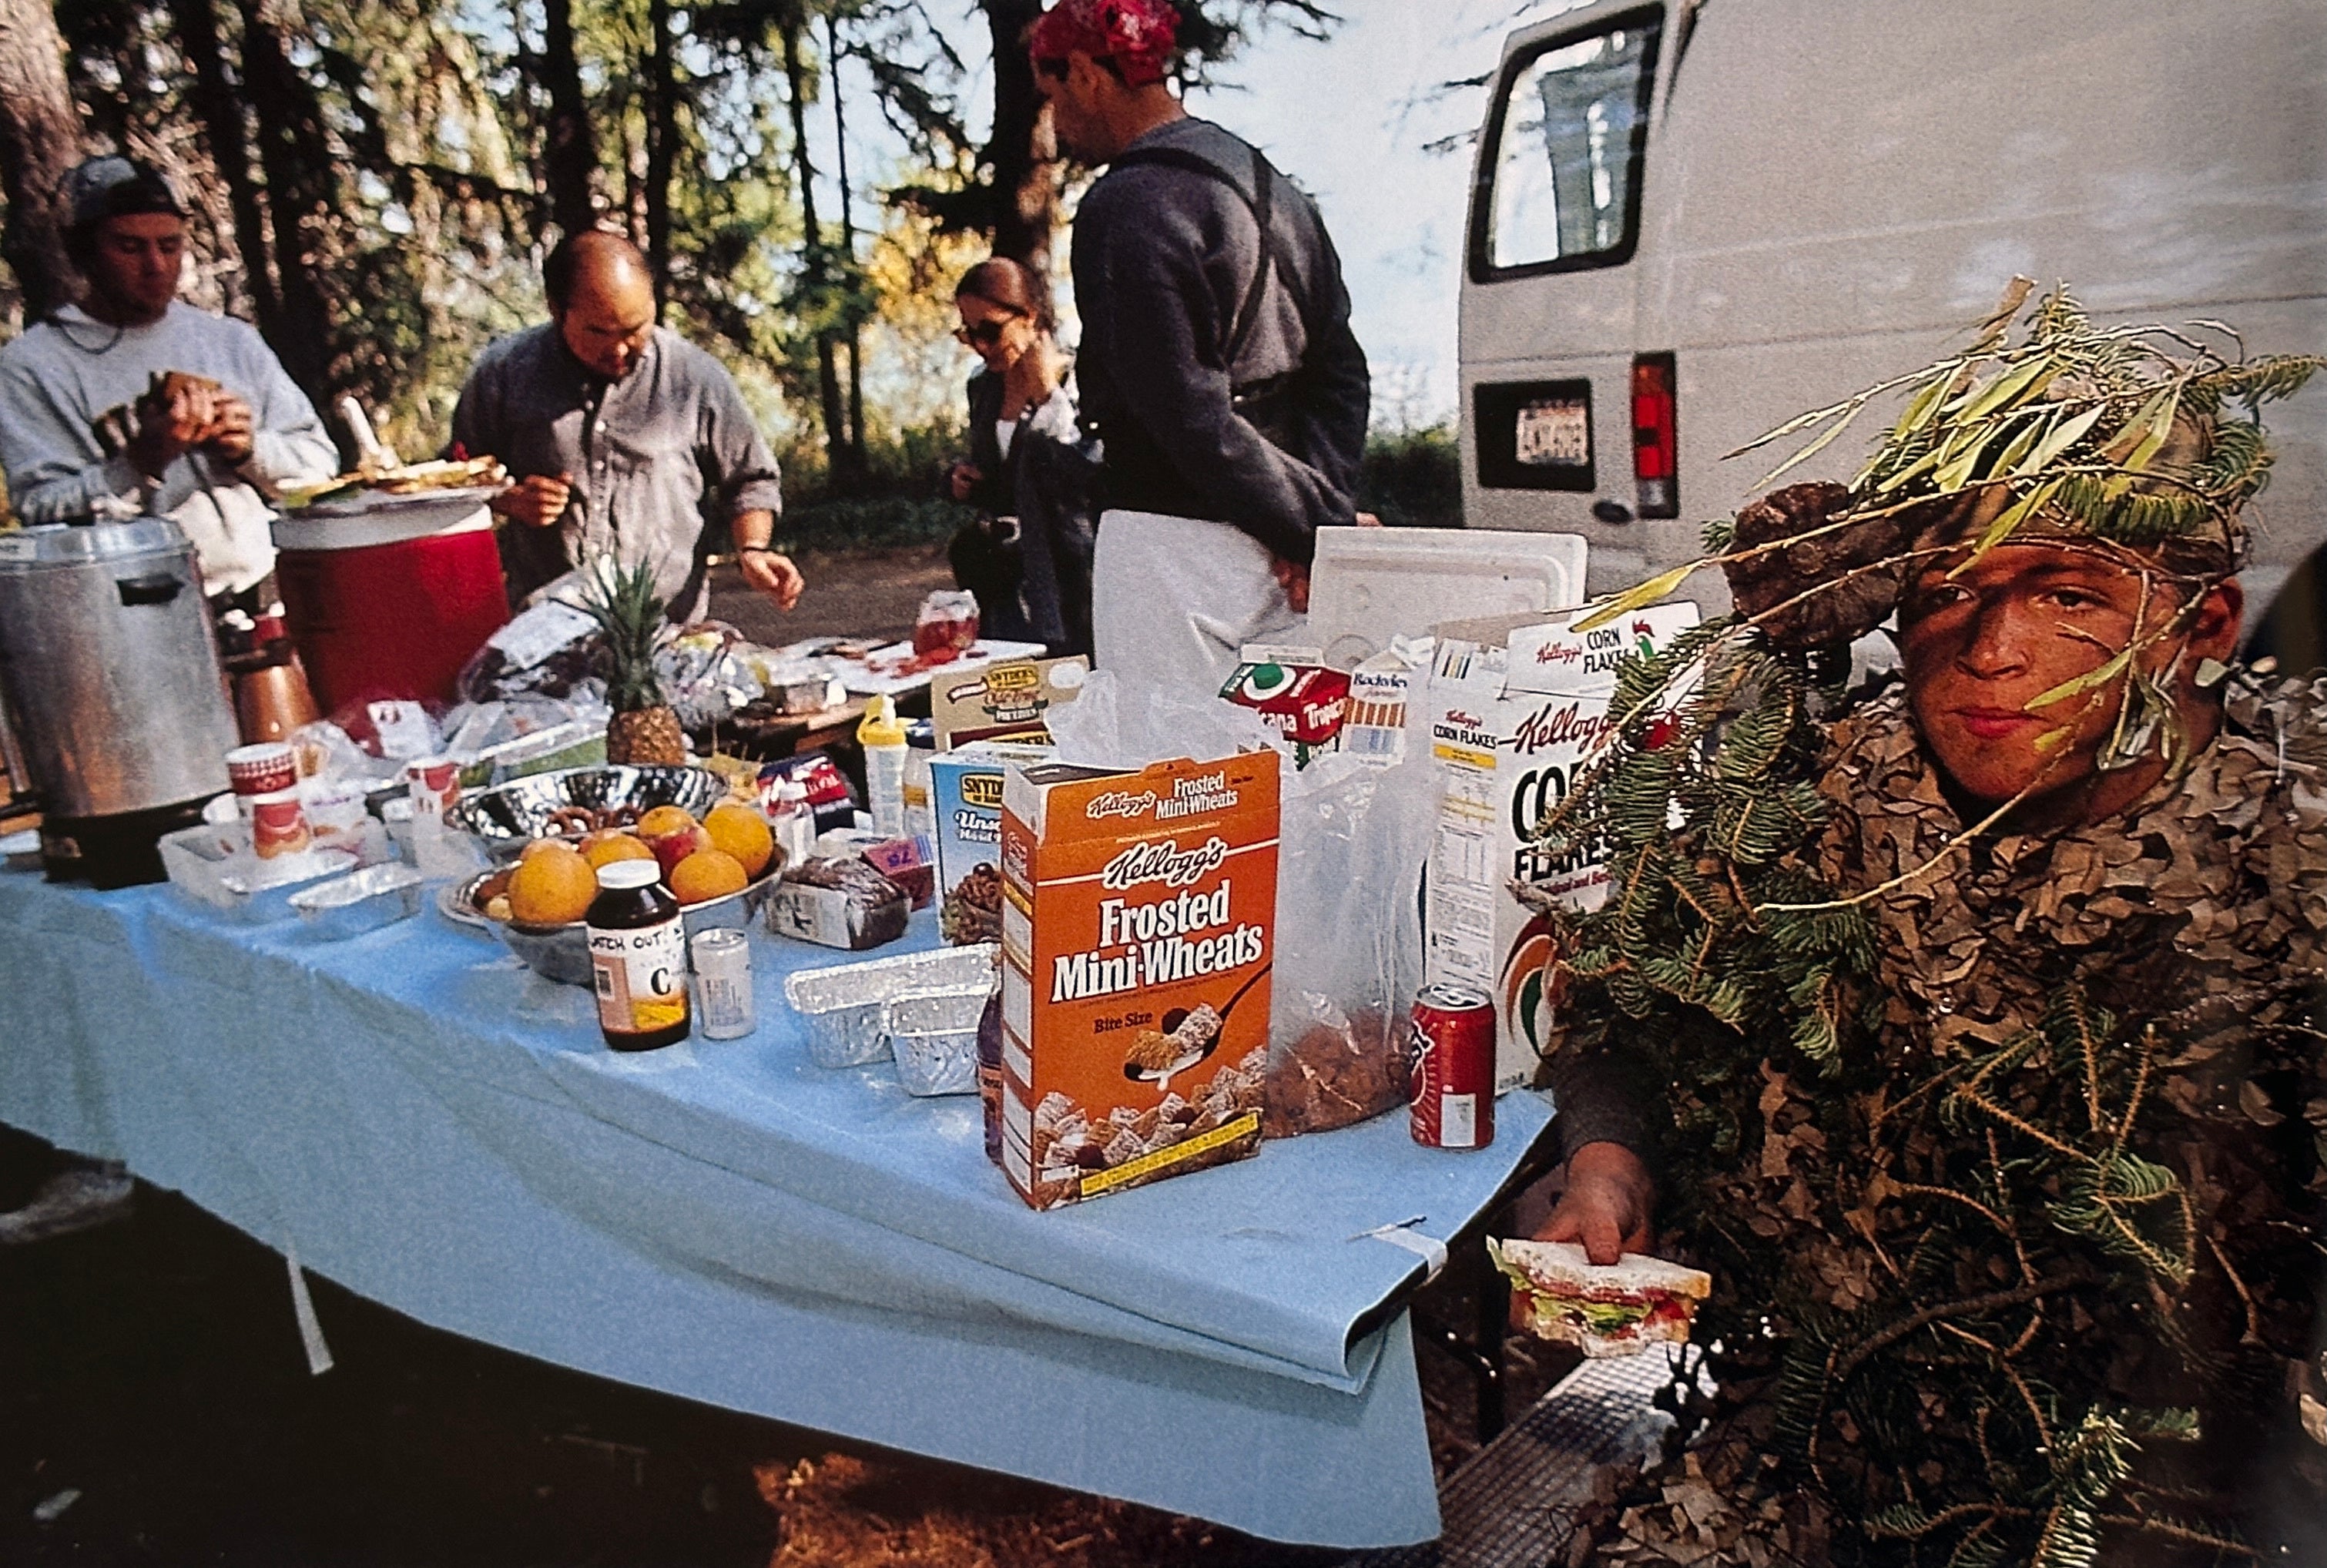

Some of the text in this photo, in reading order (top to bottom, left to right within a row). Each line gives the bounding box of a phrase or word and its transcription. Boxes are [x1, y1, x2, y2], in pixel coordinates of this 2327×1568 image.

[1587, 627, 1621, 650] CORN
[1433, 724, 1497, 750] CORN FLAKES
[1086, 770, 1225, 819] Kellogg's Frosted
[1155, 789, 1239, 819] Mini-Wheats
[1103, 836, 1229, 890] Kellogg's
[1099, 879, 1231, 949] Frosted
[1048, 923, 1263, 1003] Mini-Wheats
[650, 967, 671, 996] C
[1094, 1012, 1153, 1034] Bite Size
